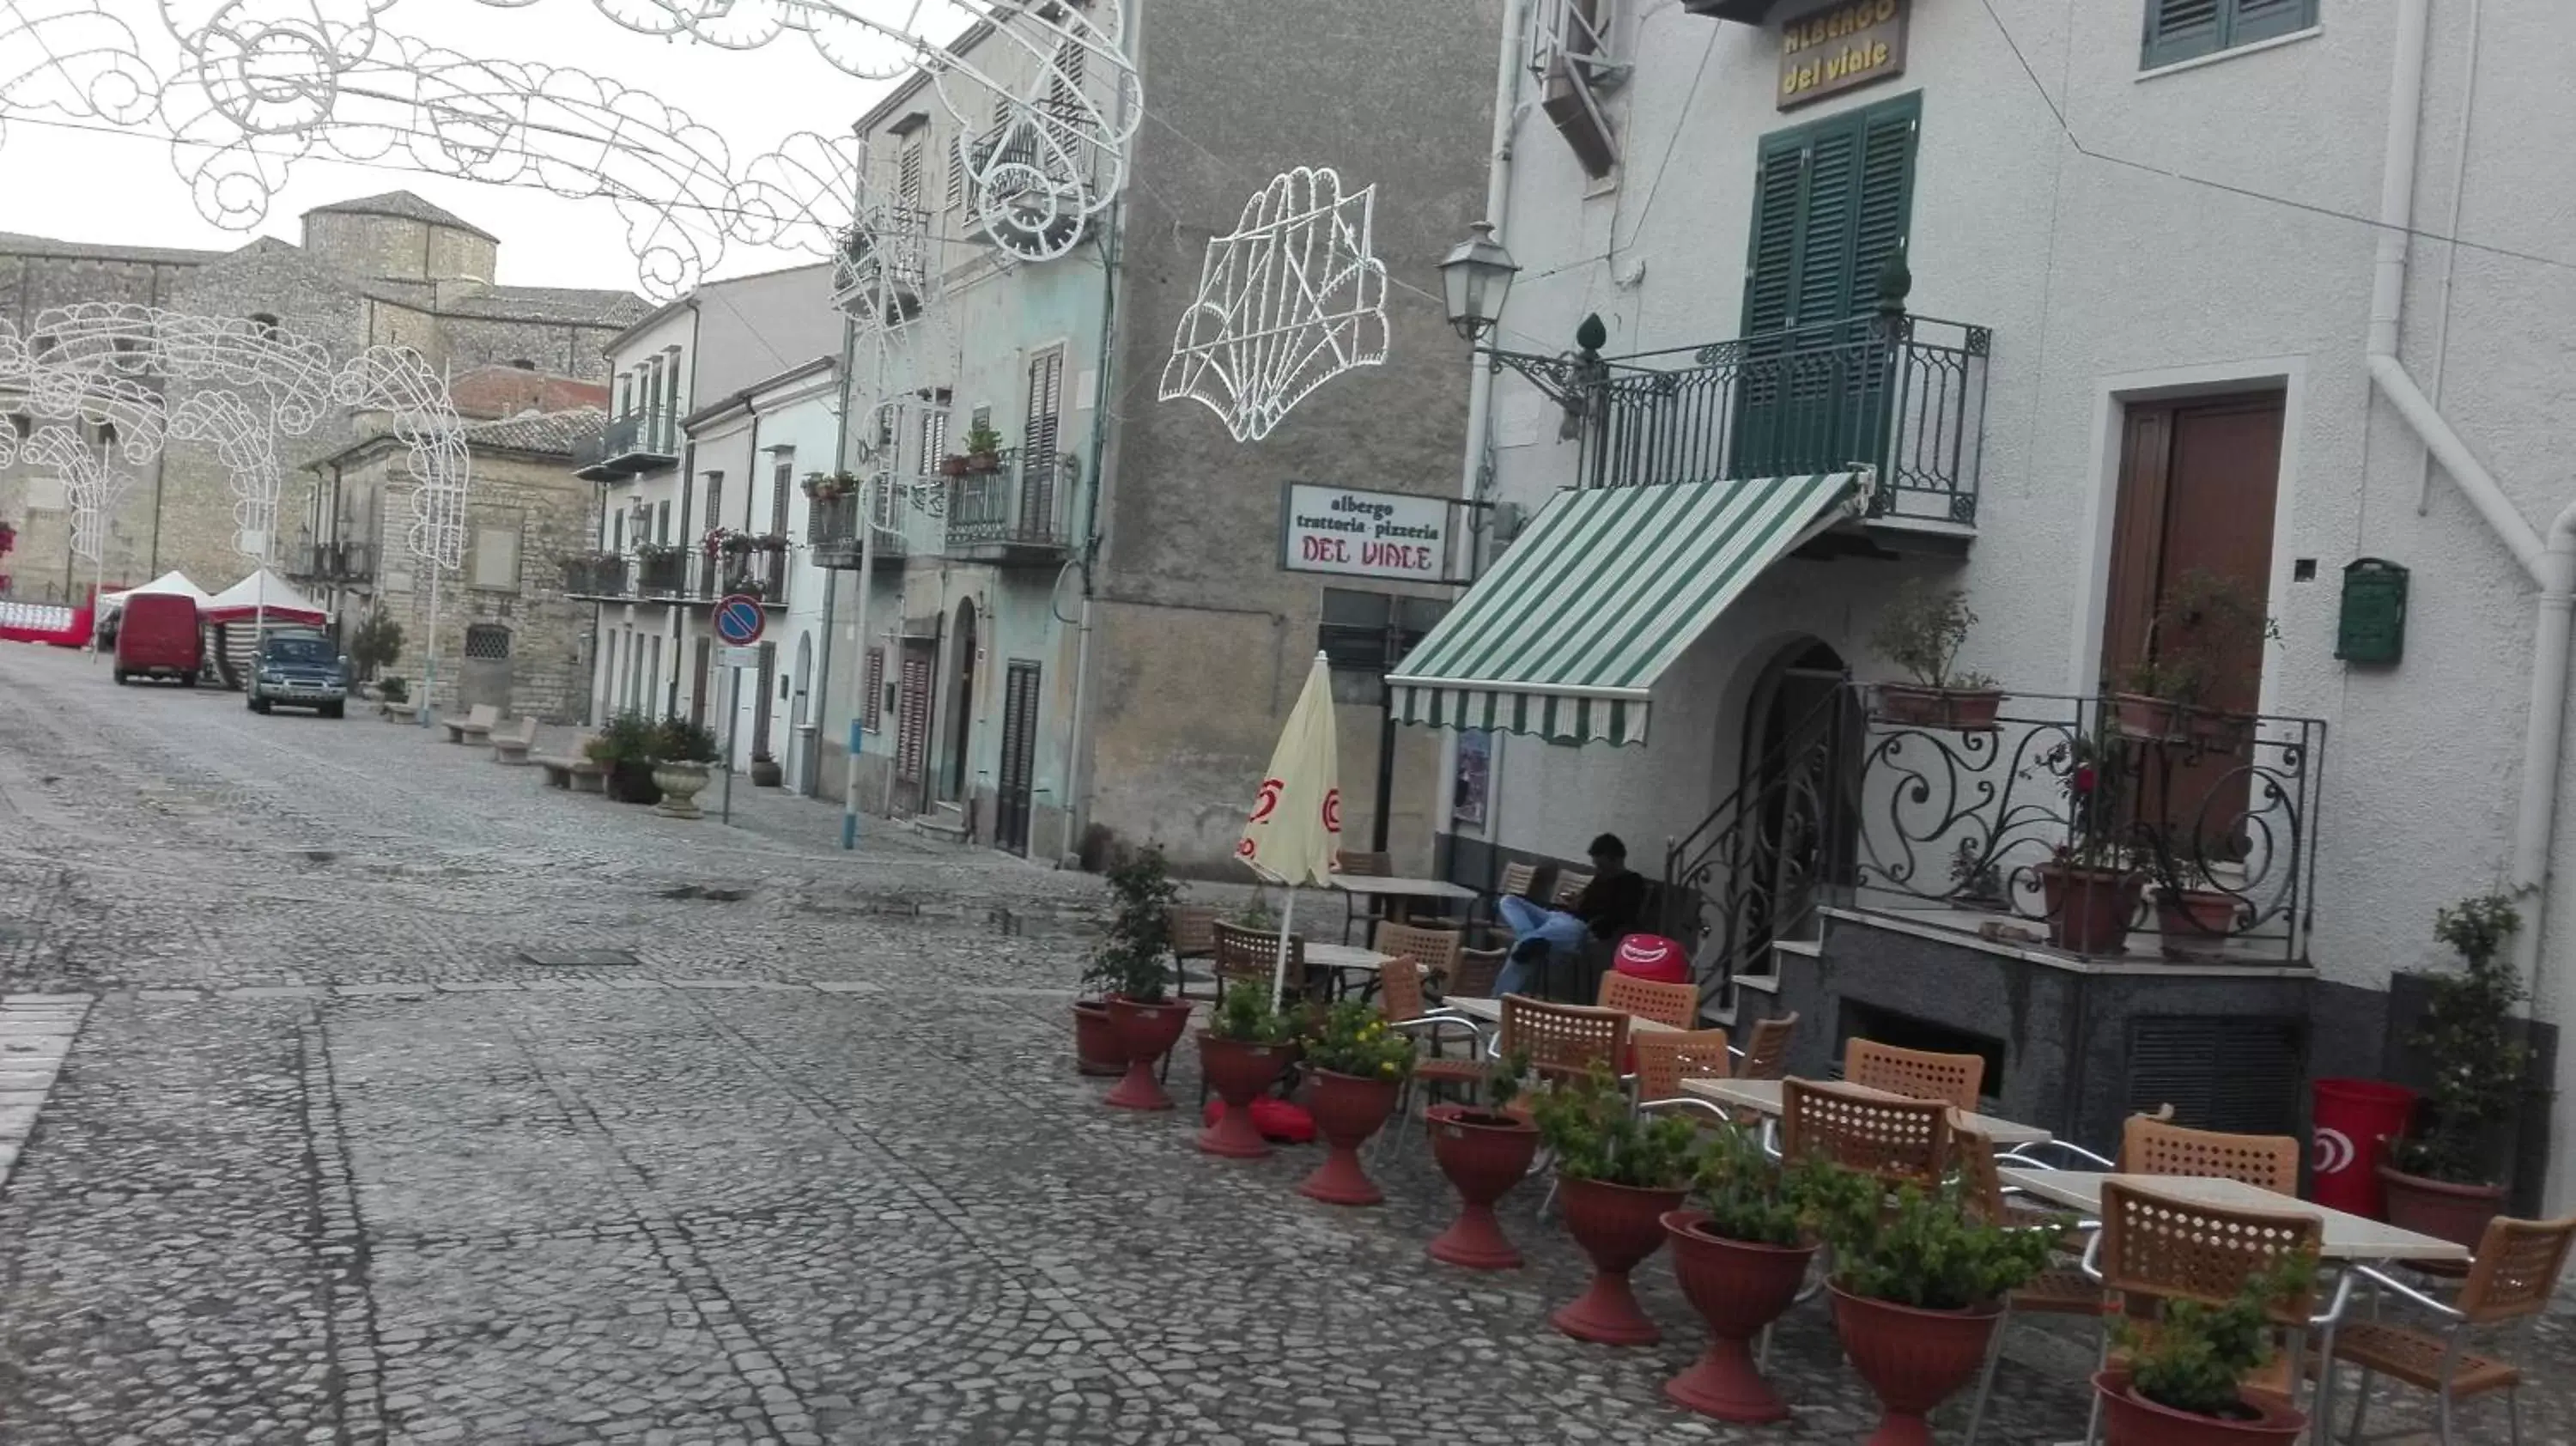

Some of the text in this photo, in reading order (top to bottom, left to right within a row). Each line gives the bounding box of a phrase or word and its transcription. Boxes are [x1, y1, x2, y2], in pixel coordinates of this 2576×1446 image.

[1783, 39, 1887, 94] del viale
[1331, 495, 1394, 520] albergo
[1297, 515, 1364, 532] trattoria
[1376, 519, 1438, 539] pizzeria
[1302, 535, 1432, 570] DEL VIALE
